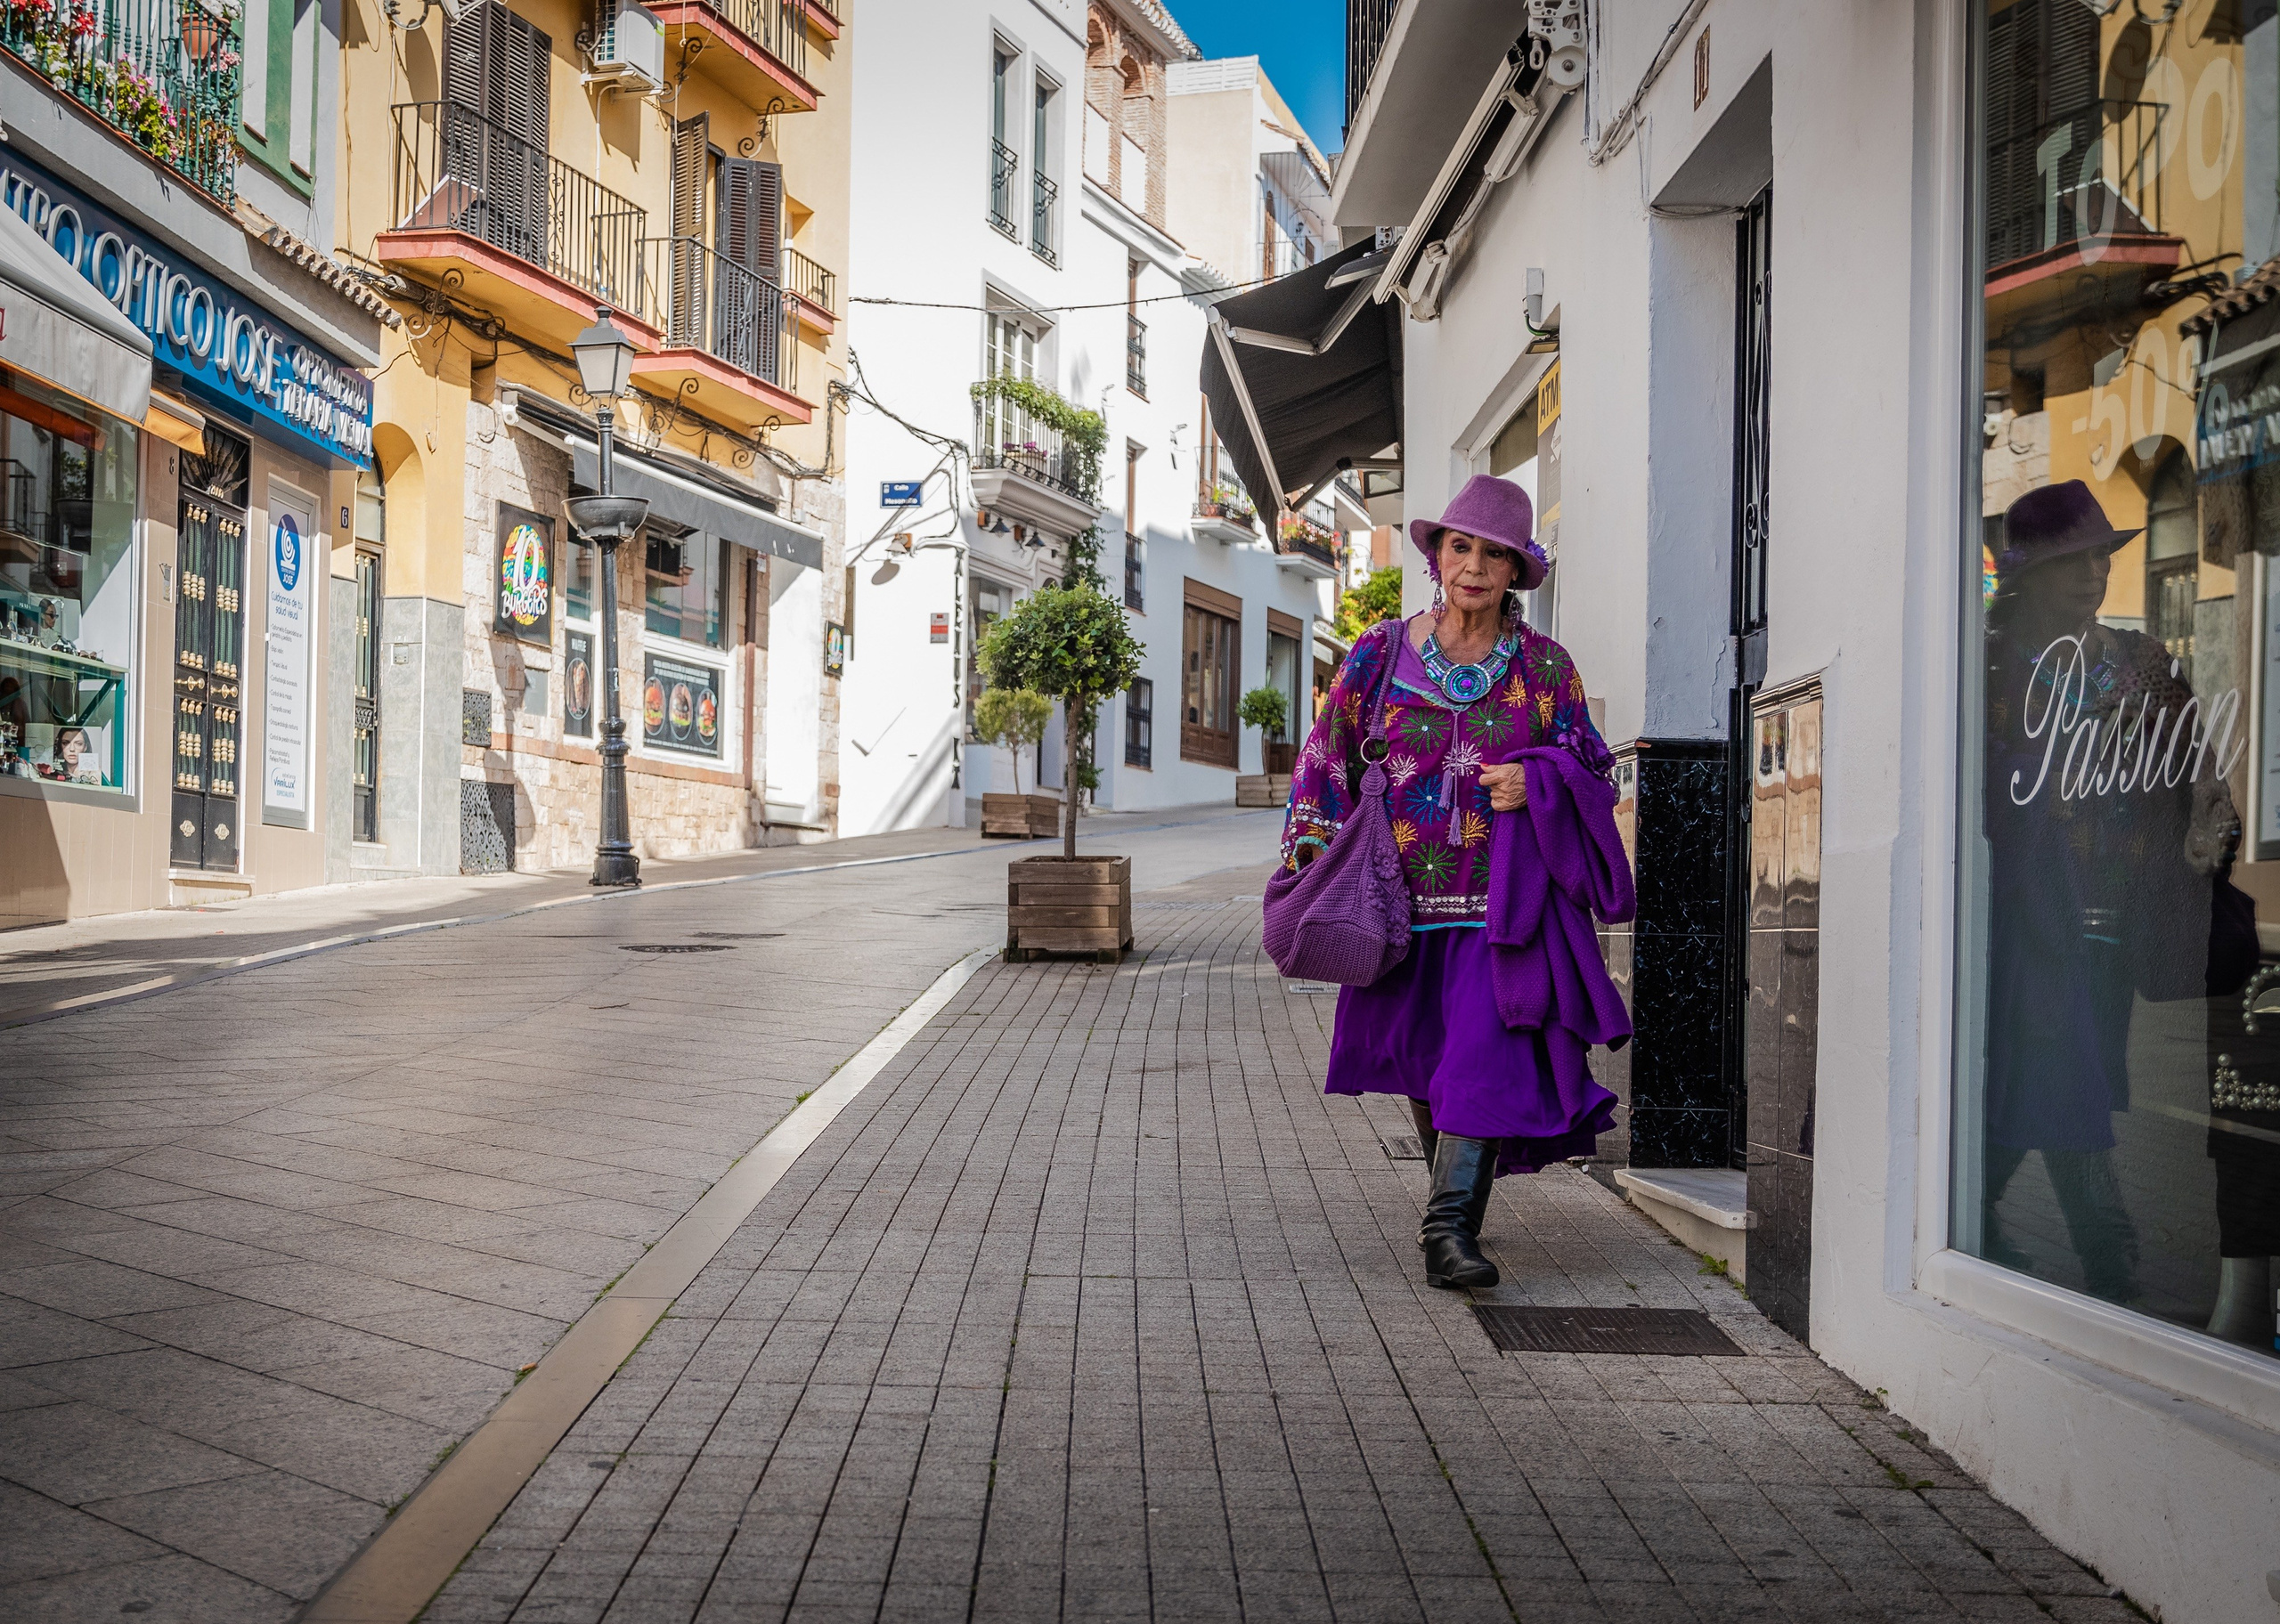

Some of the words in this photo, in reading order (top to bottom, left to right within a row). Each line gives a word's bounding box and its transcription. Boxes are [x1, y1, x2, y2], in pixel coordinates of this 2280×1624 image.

[0, 166, 84, 272] TRO
[92, 231, 215, 357] OPTICO
[215, 306, 283, 398] JOSE
[1539, 370, 1559, 425] ATM
[2072, 317, 2230, 480] -50%
[169, 456, 175, 475] 8
[342, 508, 348, 527] 6
[282, 572, 294, 586] JOSE
[512, 525, 540, 589] 10
[501, 584, 548, 618] BURGERS
[2010, 630, 2245, 805] Passion
